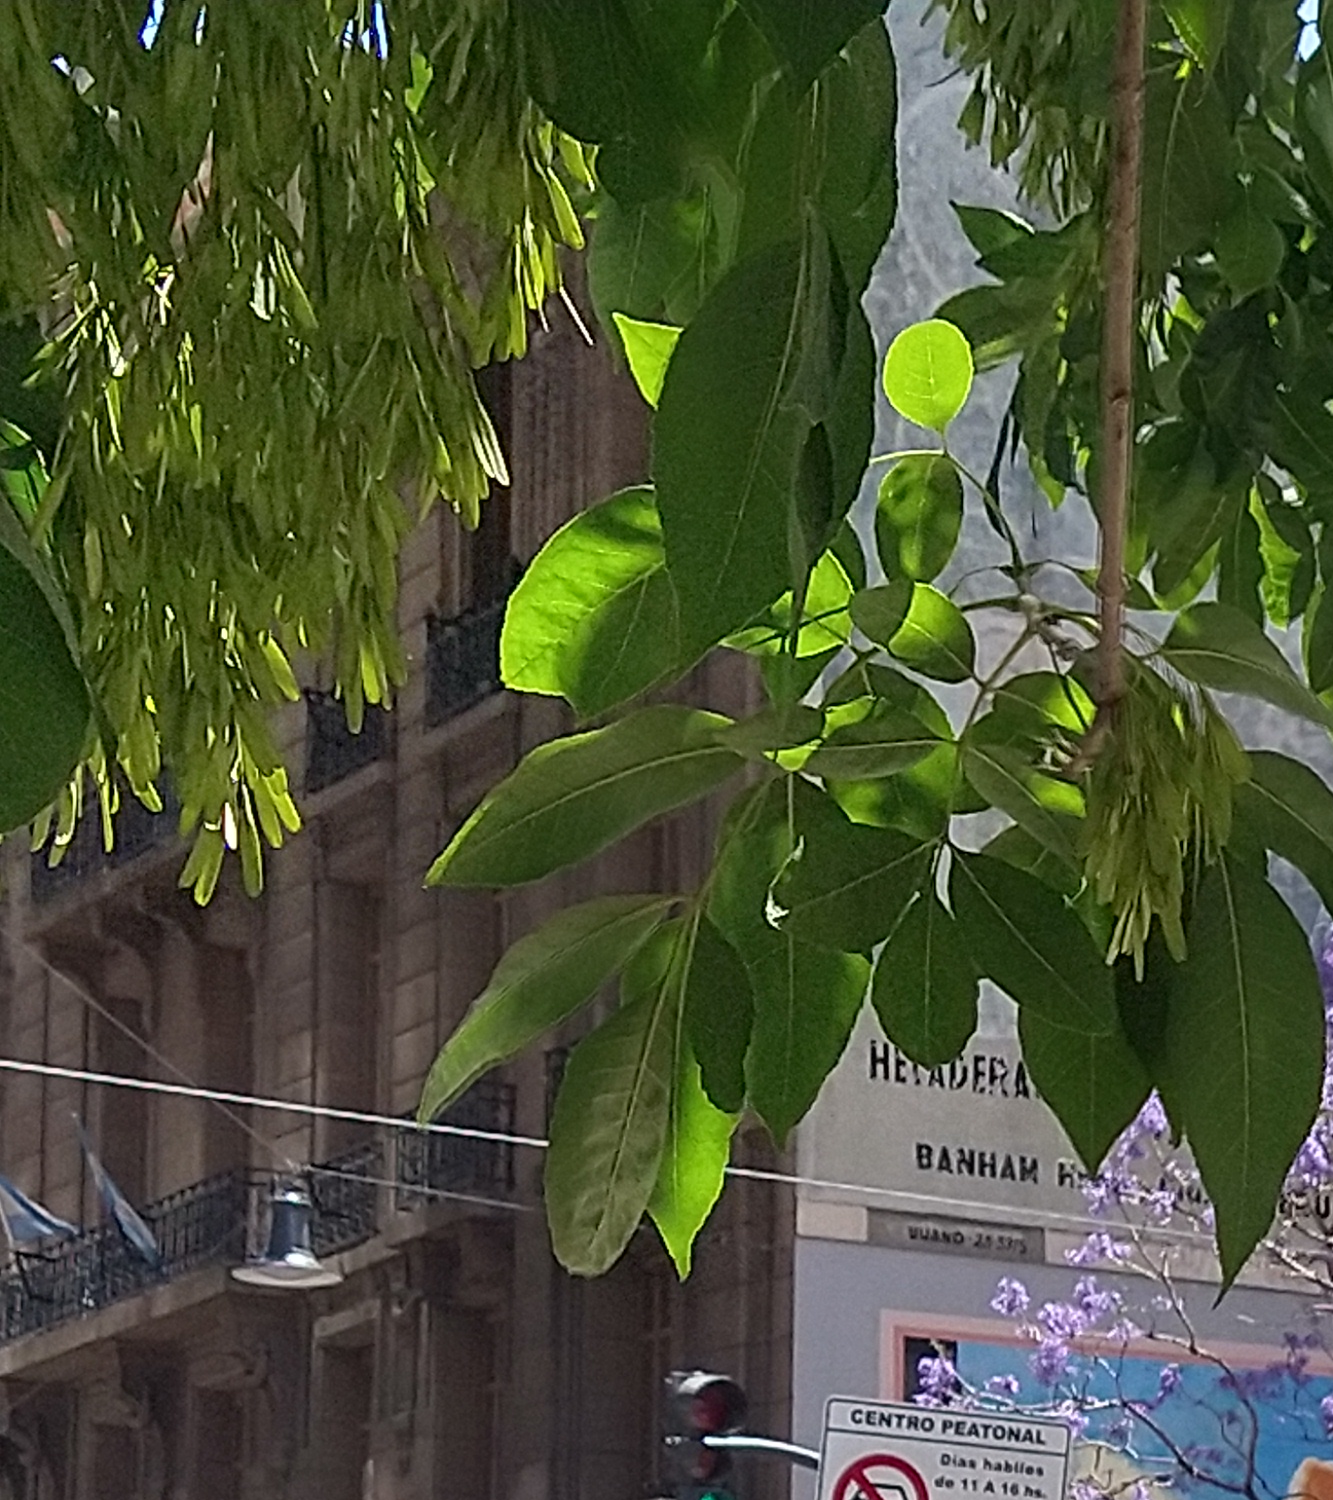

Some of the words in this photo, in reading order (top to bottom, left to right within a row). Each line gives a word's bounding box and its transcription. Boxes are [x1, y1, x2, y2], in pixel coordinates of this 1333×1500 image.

[915, 1142, 1039, 1185] BANHAM
[850, 1408, 935, 1433] CENTRO
[941, 1419, 1047, 1445] PEATONAL
[934, 1476, 954, 1489] de
[961, 1478, 977, 1491] 11
[983, 1480, 995, 1494] A
[1001, 1482, 1019, 1497] 16
[1023, 1485, 1047, 1499] hs.
